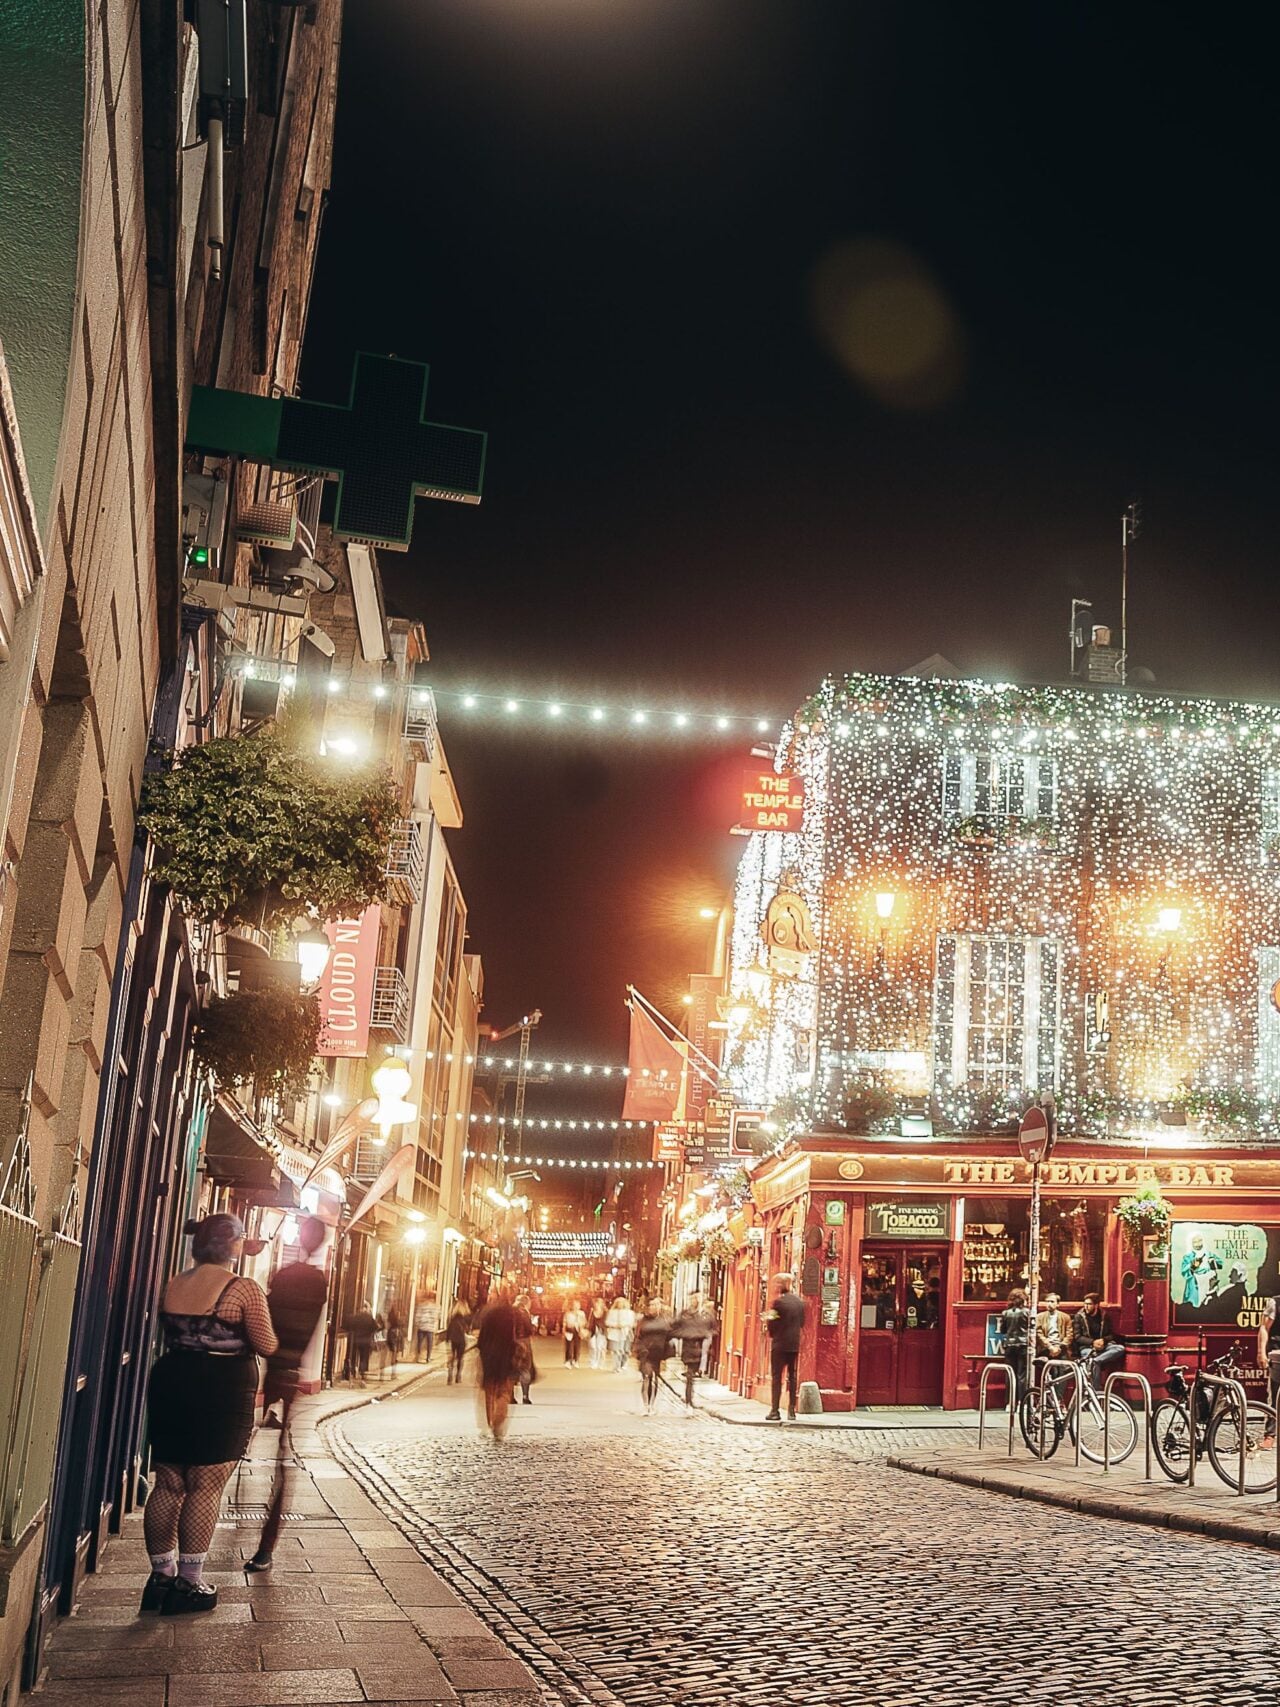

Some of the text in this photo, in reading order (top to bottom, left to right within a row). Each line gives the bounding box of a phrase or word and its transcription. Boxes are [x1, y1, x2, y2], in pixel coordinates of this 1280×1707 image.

[759, 776, 790, 792] THE
[743, 793, 803, 809] TEMPLE
[757, 812, 788, 827] BAR
[328, 951, 358, 1032] CLOUD
[943, 1162, 1235, 1186] THE TEMPLE BAR
[877, 1210, 939, 1232] TOBACCO
[1225, 1229, 1249, 1240] THE
[1213, 1239, 1259, 1250] TEMPLE
[1225, 1250, 1249, 1260] BAR
[1227, 1368, 1270, 1379] TEMPL
